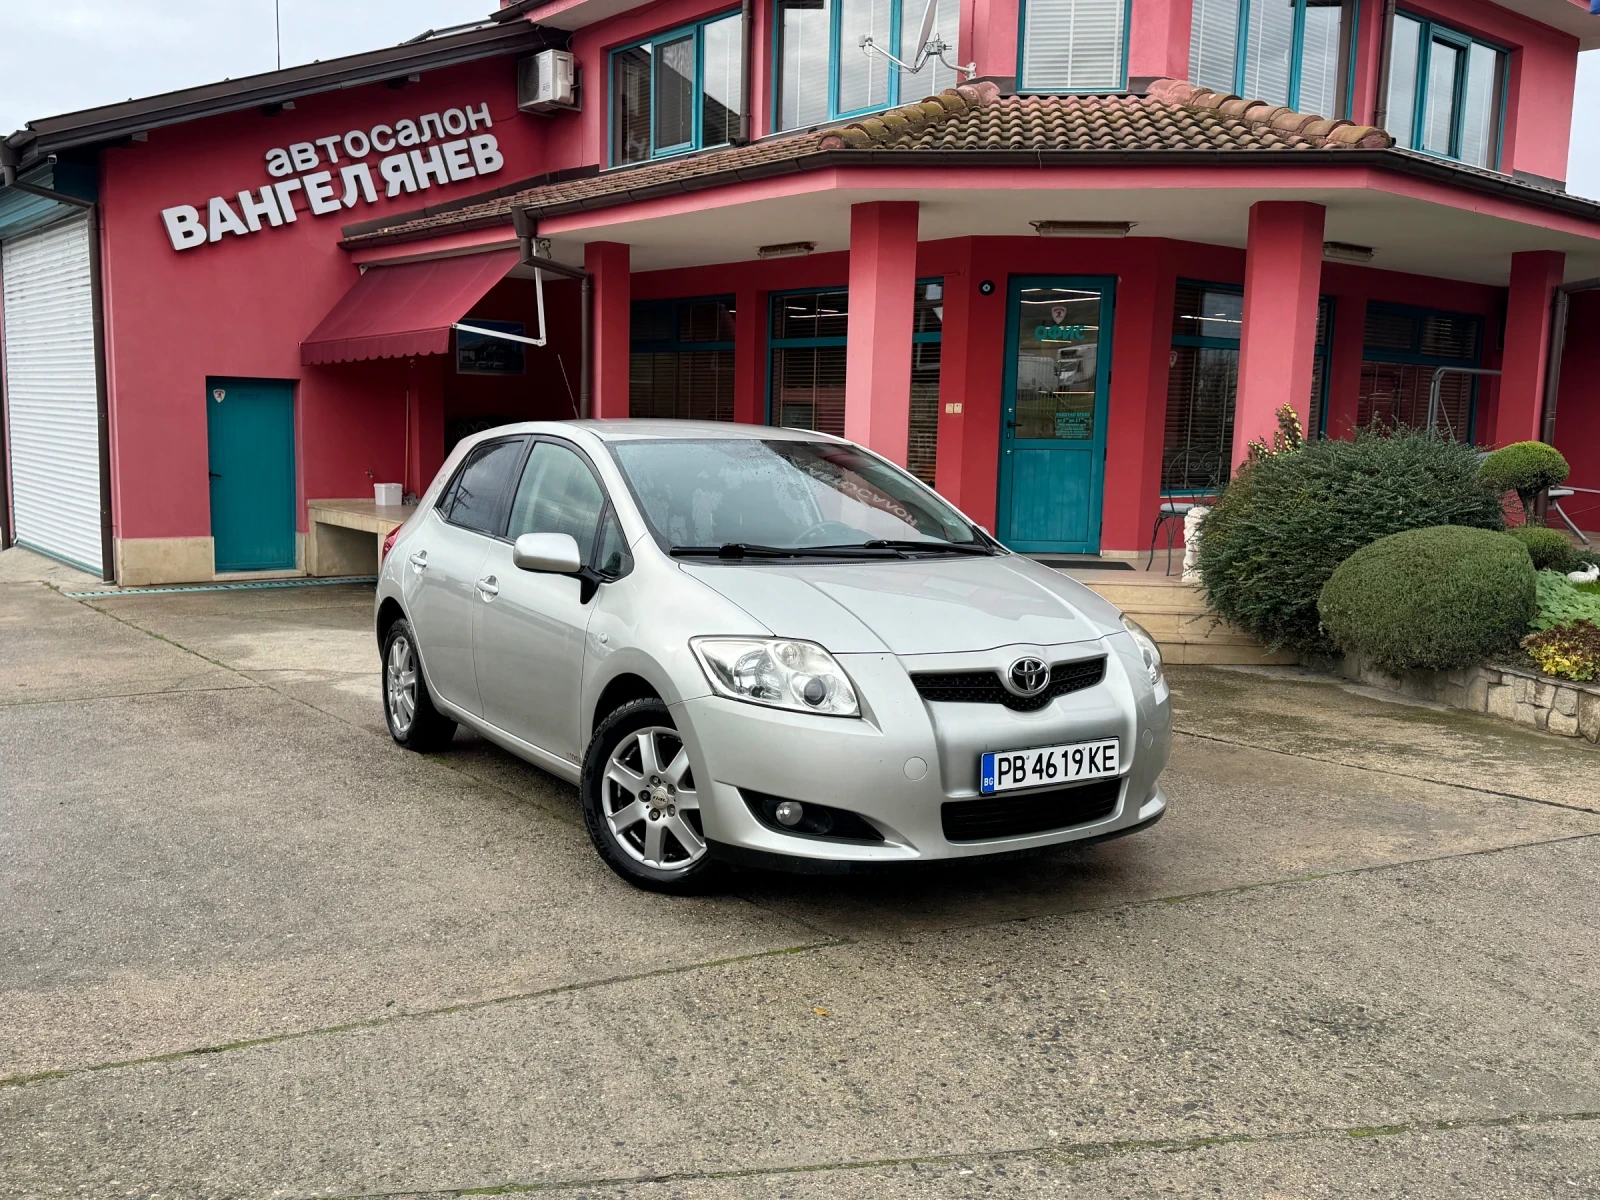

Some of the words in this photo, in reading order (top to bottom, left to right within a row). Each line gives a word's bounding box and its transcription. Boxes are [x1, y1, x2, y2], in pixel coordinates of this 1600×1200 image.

[265, 102, 493, 177] автосалон
[161, 162, 378, 250] ВАНГЕЛ
[379, 134, 504, 198] ЯНЕВ
[1034, 324, 1085, 341] ОФИС
[984, 777, 994, 787] BG
[998, 756, 1026, 786] PB
[1032, 749, 1084, 780] 4619
[1089, 745, 1115, 773] KE
